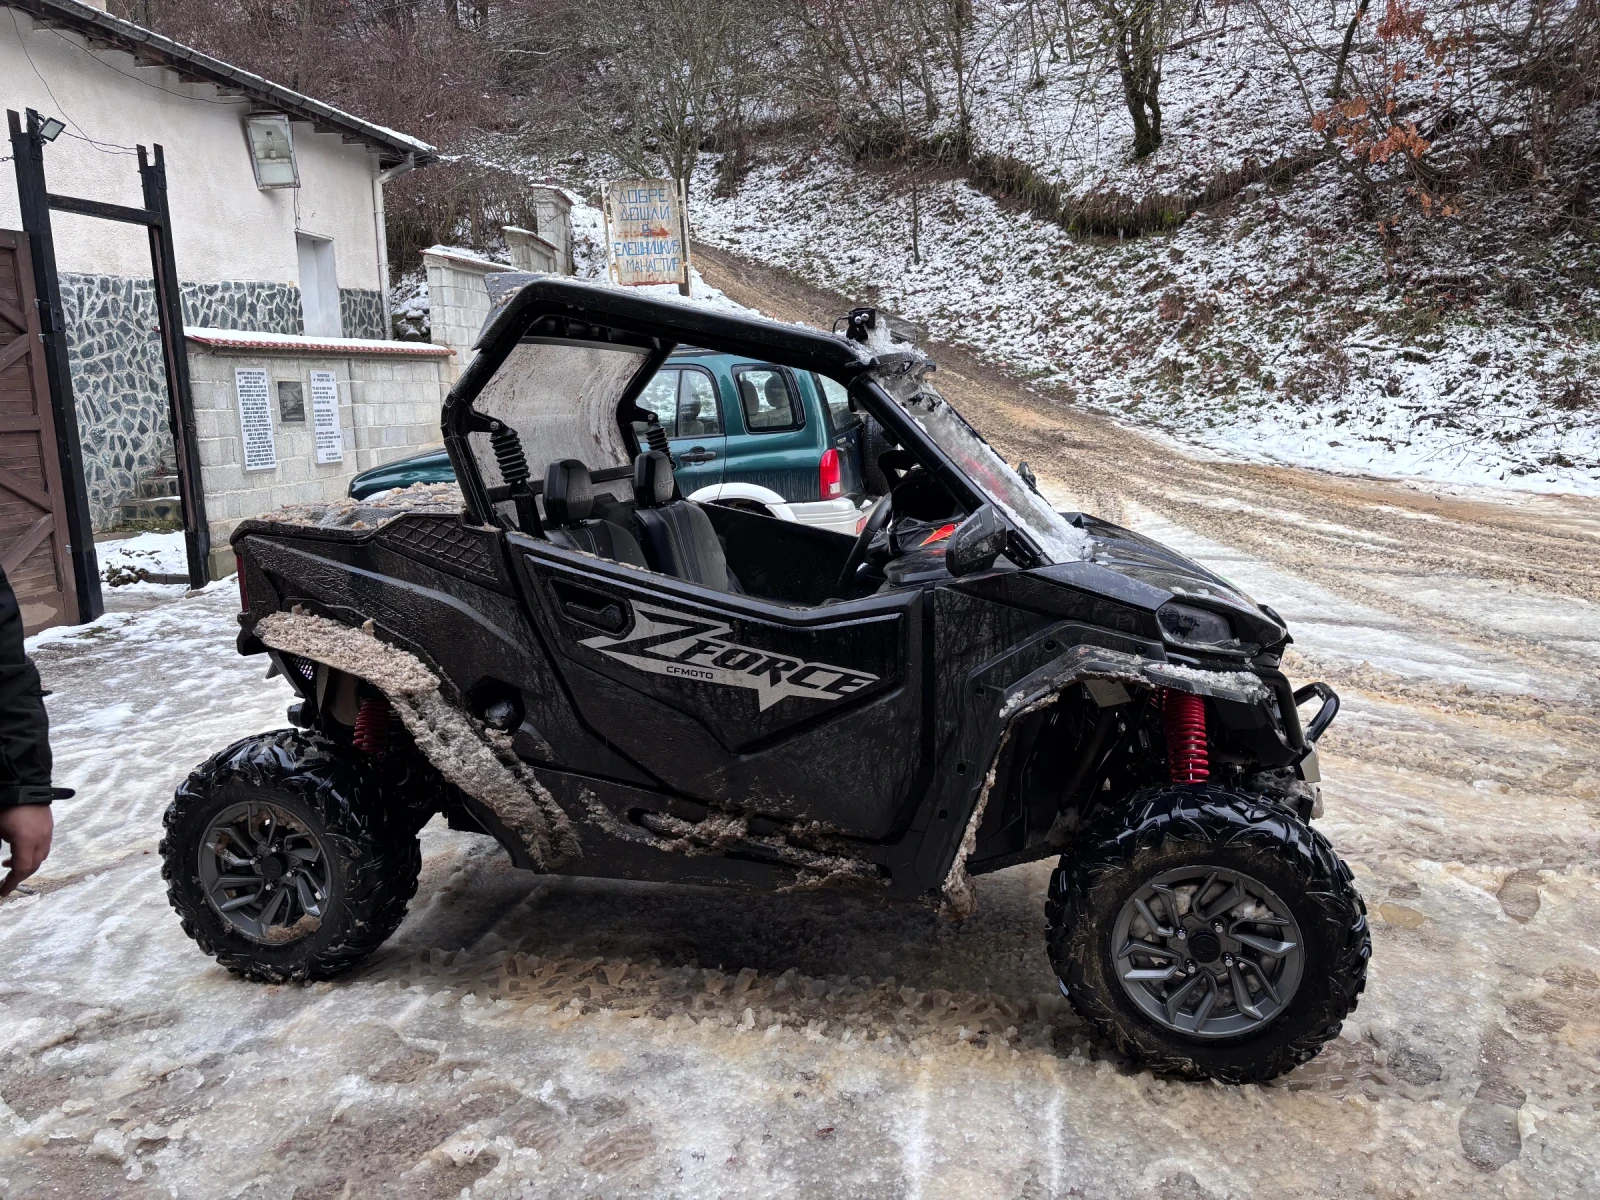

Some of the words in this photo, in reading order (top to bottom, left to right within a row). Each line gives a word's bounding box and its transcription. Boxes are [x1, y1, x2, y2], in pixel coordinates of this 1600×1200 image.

[619, 188, 669, 204] ДОБРЕ
[620, 206, 671, 221] ДОШЛИ
[626, 257, 681, 273] МАНАСТИР
[666, 665, 714, 680] CFMOTO
